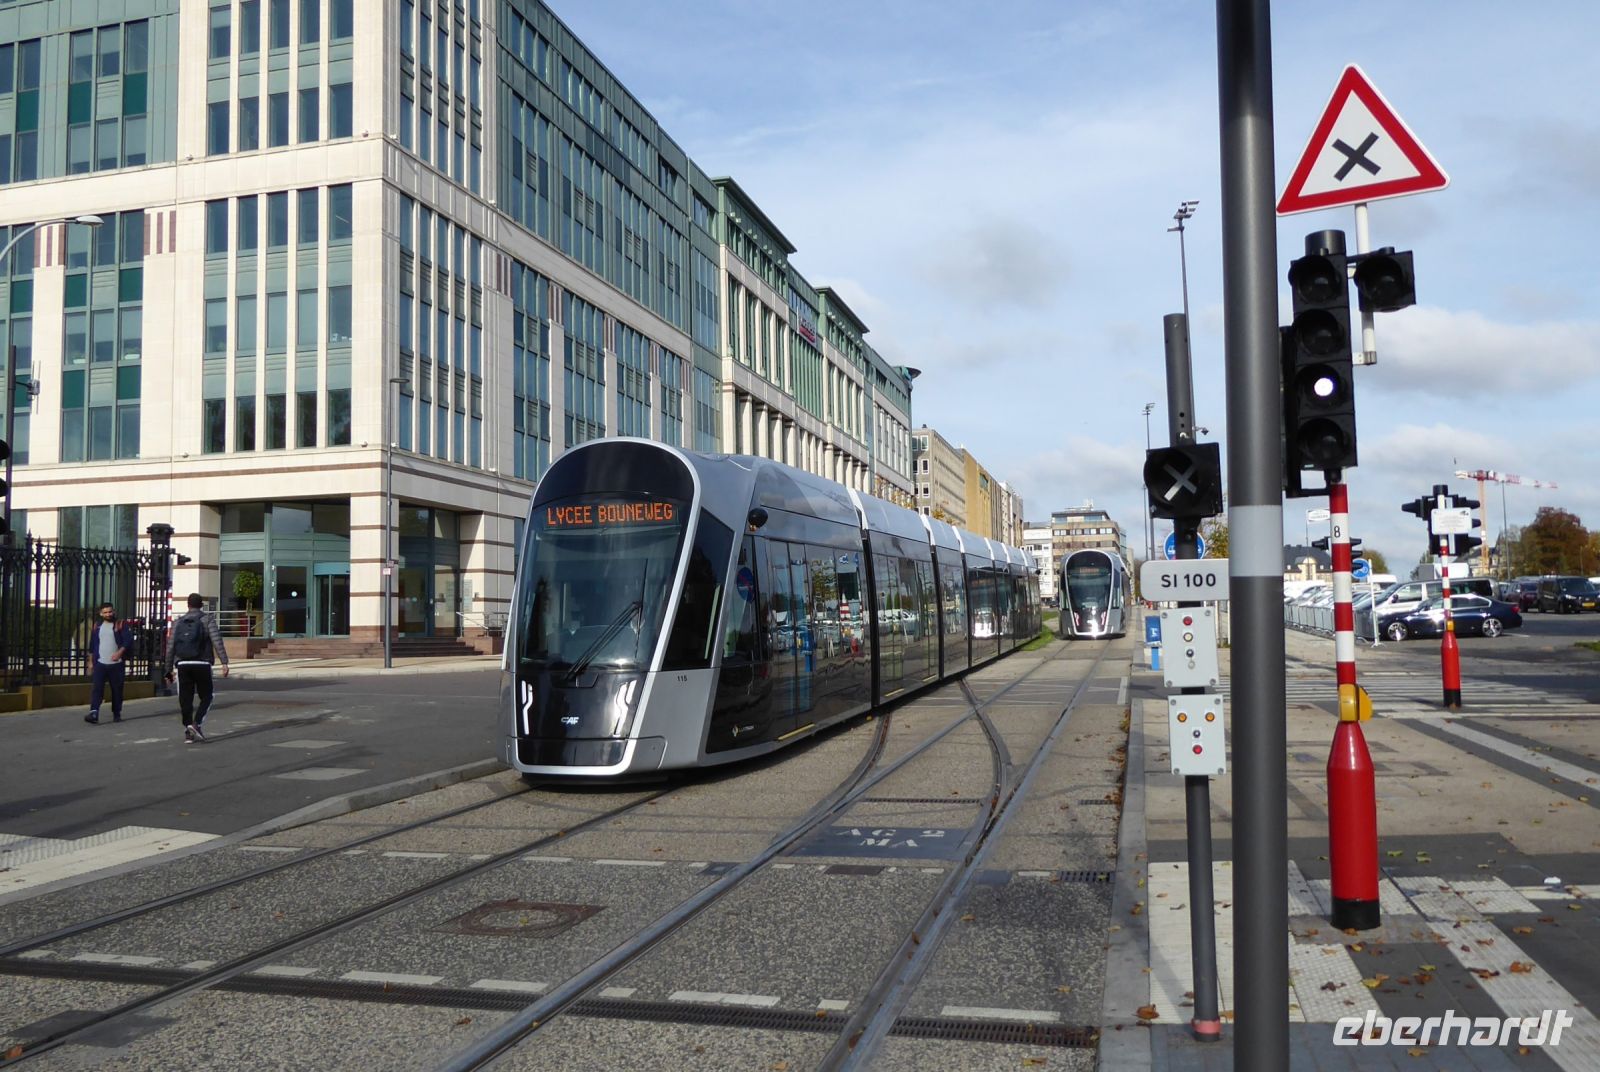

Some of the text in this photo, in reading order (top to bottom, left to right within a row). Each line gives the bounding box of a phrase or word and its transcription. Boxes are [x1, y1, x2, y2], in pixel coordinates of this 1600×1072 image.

[547, 502, 673, 525] LYCEE BOUNEWEG
[1333, 525, 1341, 538] 8
[1161, 573, 1217, 588] SI 100
[560, 716, 580, 725] CAF
